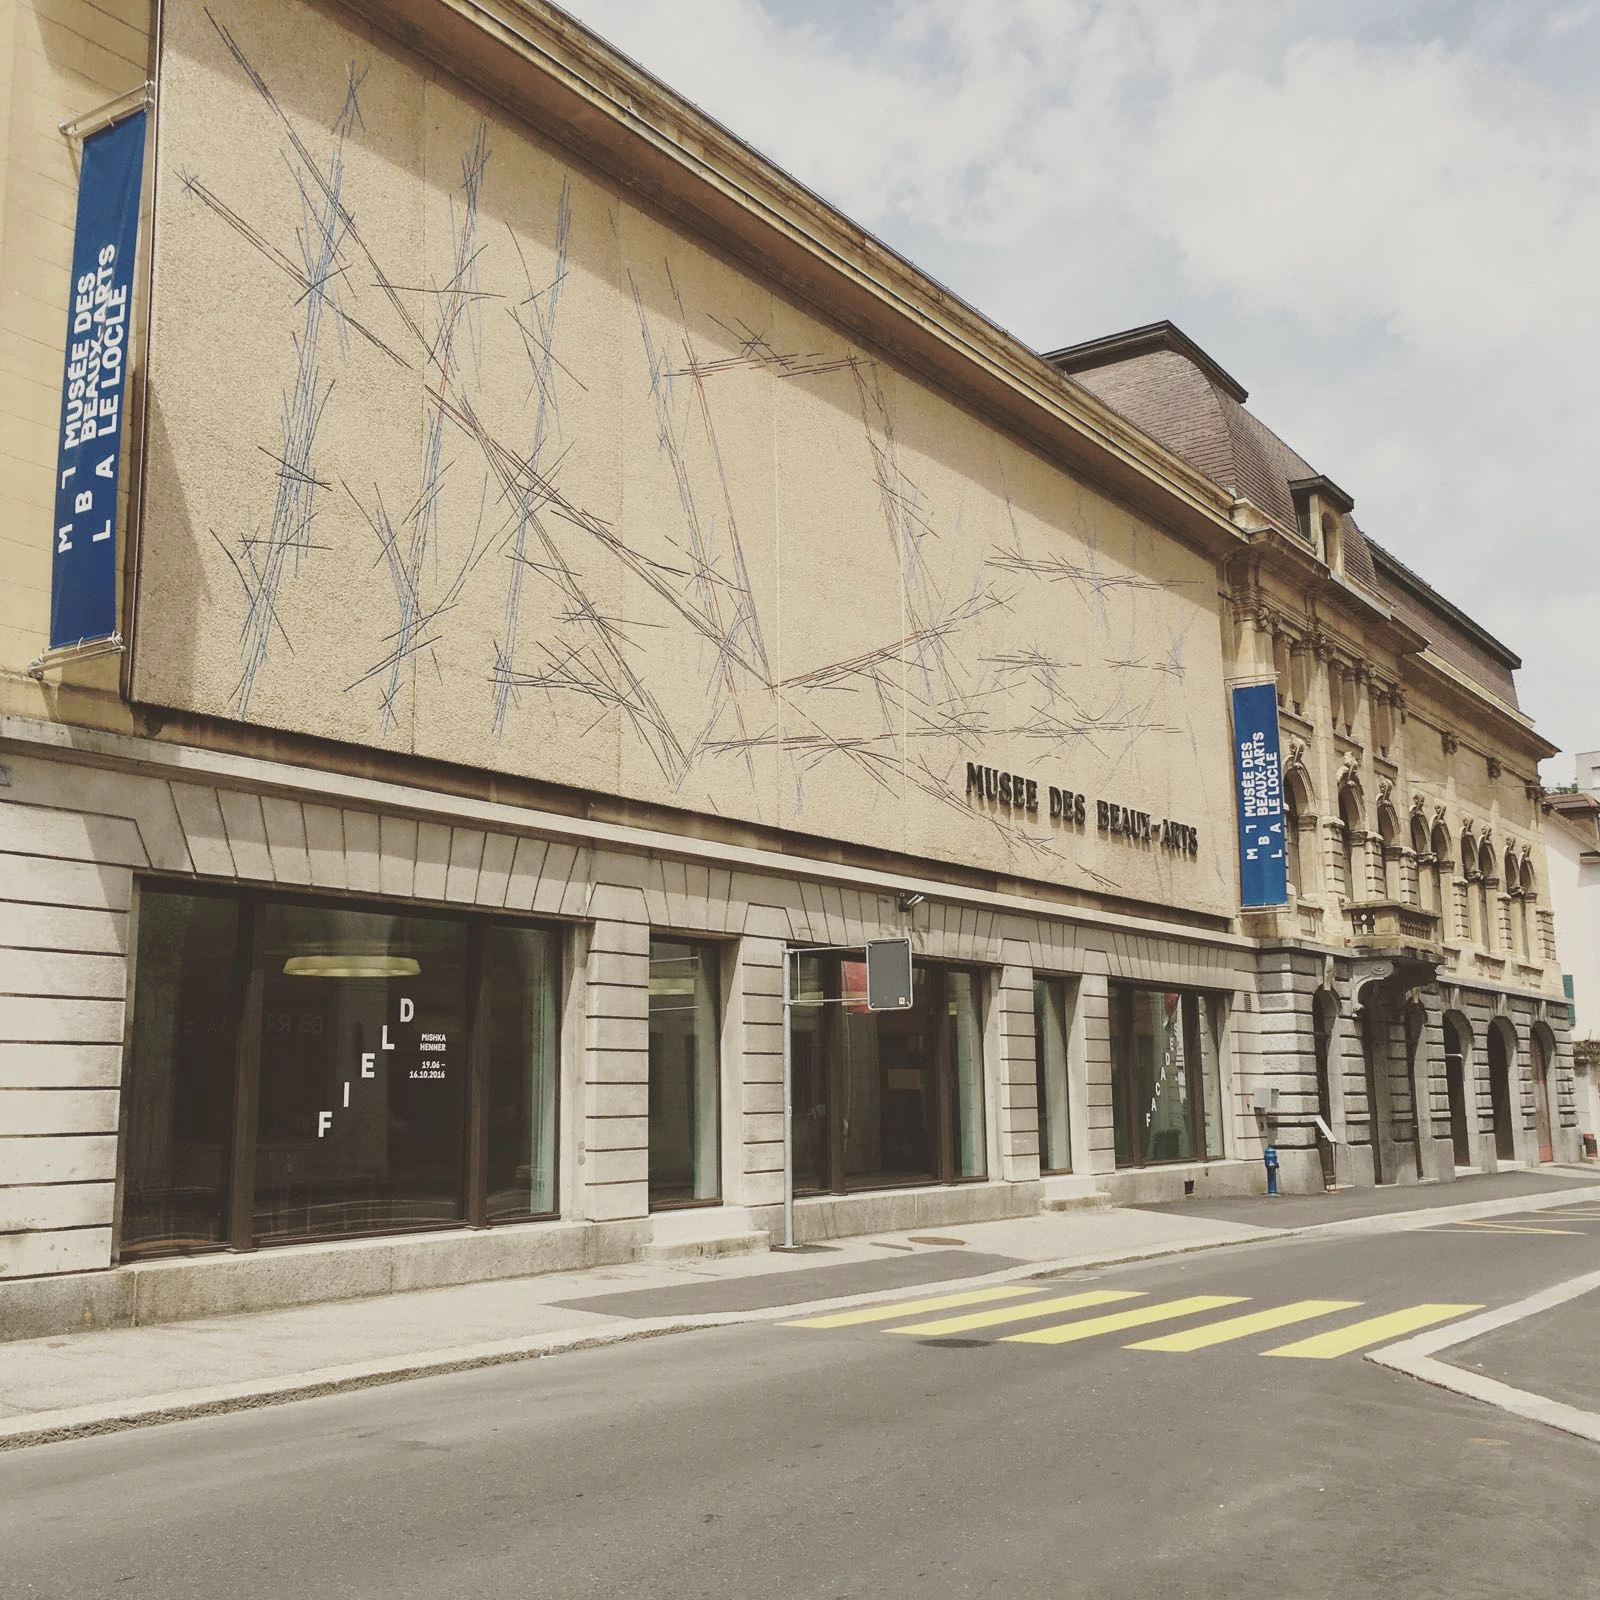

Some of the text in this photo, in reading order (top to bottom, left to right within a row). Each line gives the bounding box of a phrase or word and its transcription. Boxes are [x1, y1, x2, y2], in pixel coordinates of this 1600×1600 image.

[64, 272, 96, 450] MUSÉE DES
[80, 244, 116, 443] BEAUX-ARTS
[98, 285, 127, 437] LE LOCLE
[966, 762, 1198, 856] MUSEE DES BEAUX-ARTS
[1241, 742, 1256, 817] MUSÉE DES
[1252, 731, 1269, 817] BEAUX-ARTS
[1266, 752, 1281, 815] LE LOCLE
[409, 1070, 445, 1078] 16.10.2016
[420, 1043, 446, 1051] HENNER
[421, 1033, 446, 1041] MISHKA
[421, 1061, 440, 1069] 19.06
